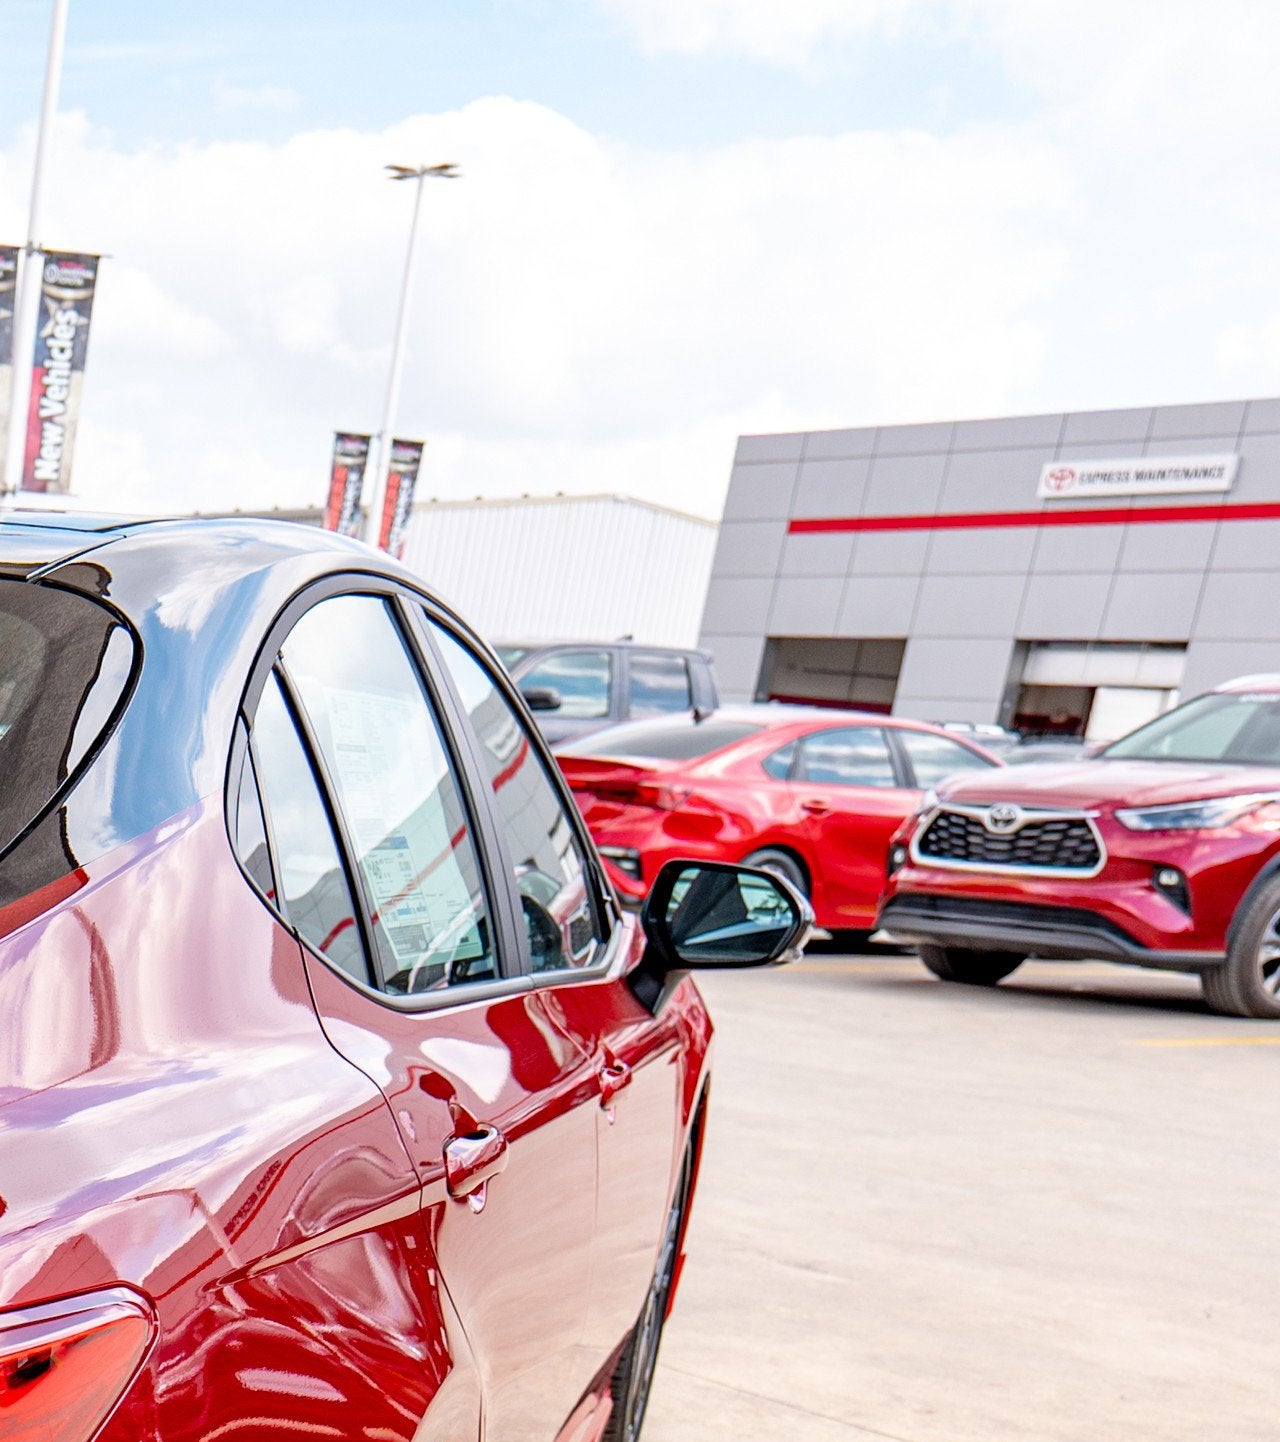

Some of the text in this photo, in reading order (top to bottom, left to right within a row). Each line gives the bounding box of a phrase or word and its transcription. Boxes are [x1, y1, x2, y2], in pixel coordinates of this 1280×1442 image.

[38, 309, 79, 419] Vehicles
[34, 421, 65, 481] New
[1079, 466, 1225, 486] EXPRESS MAINTENANCE
